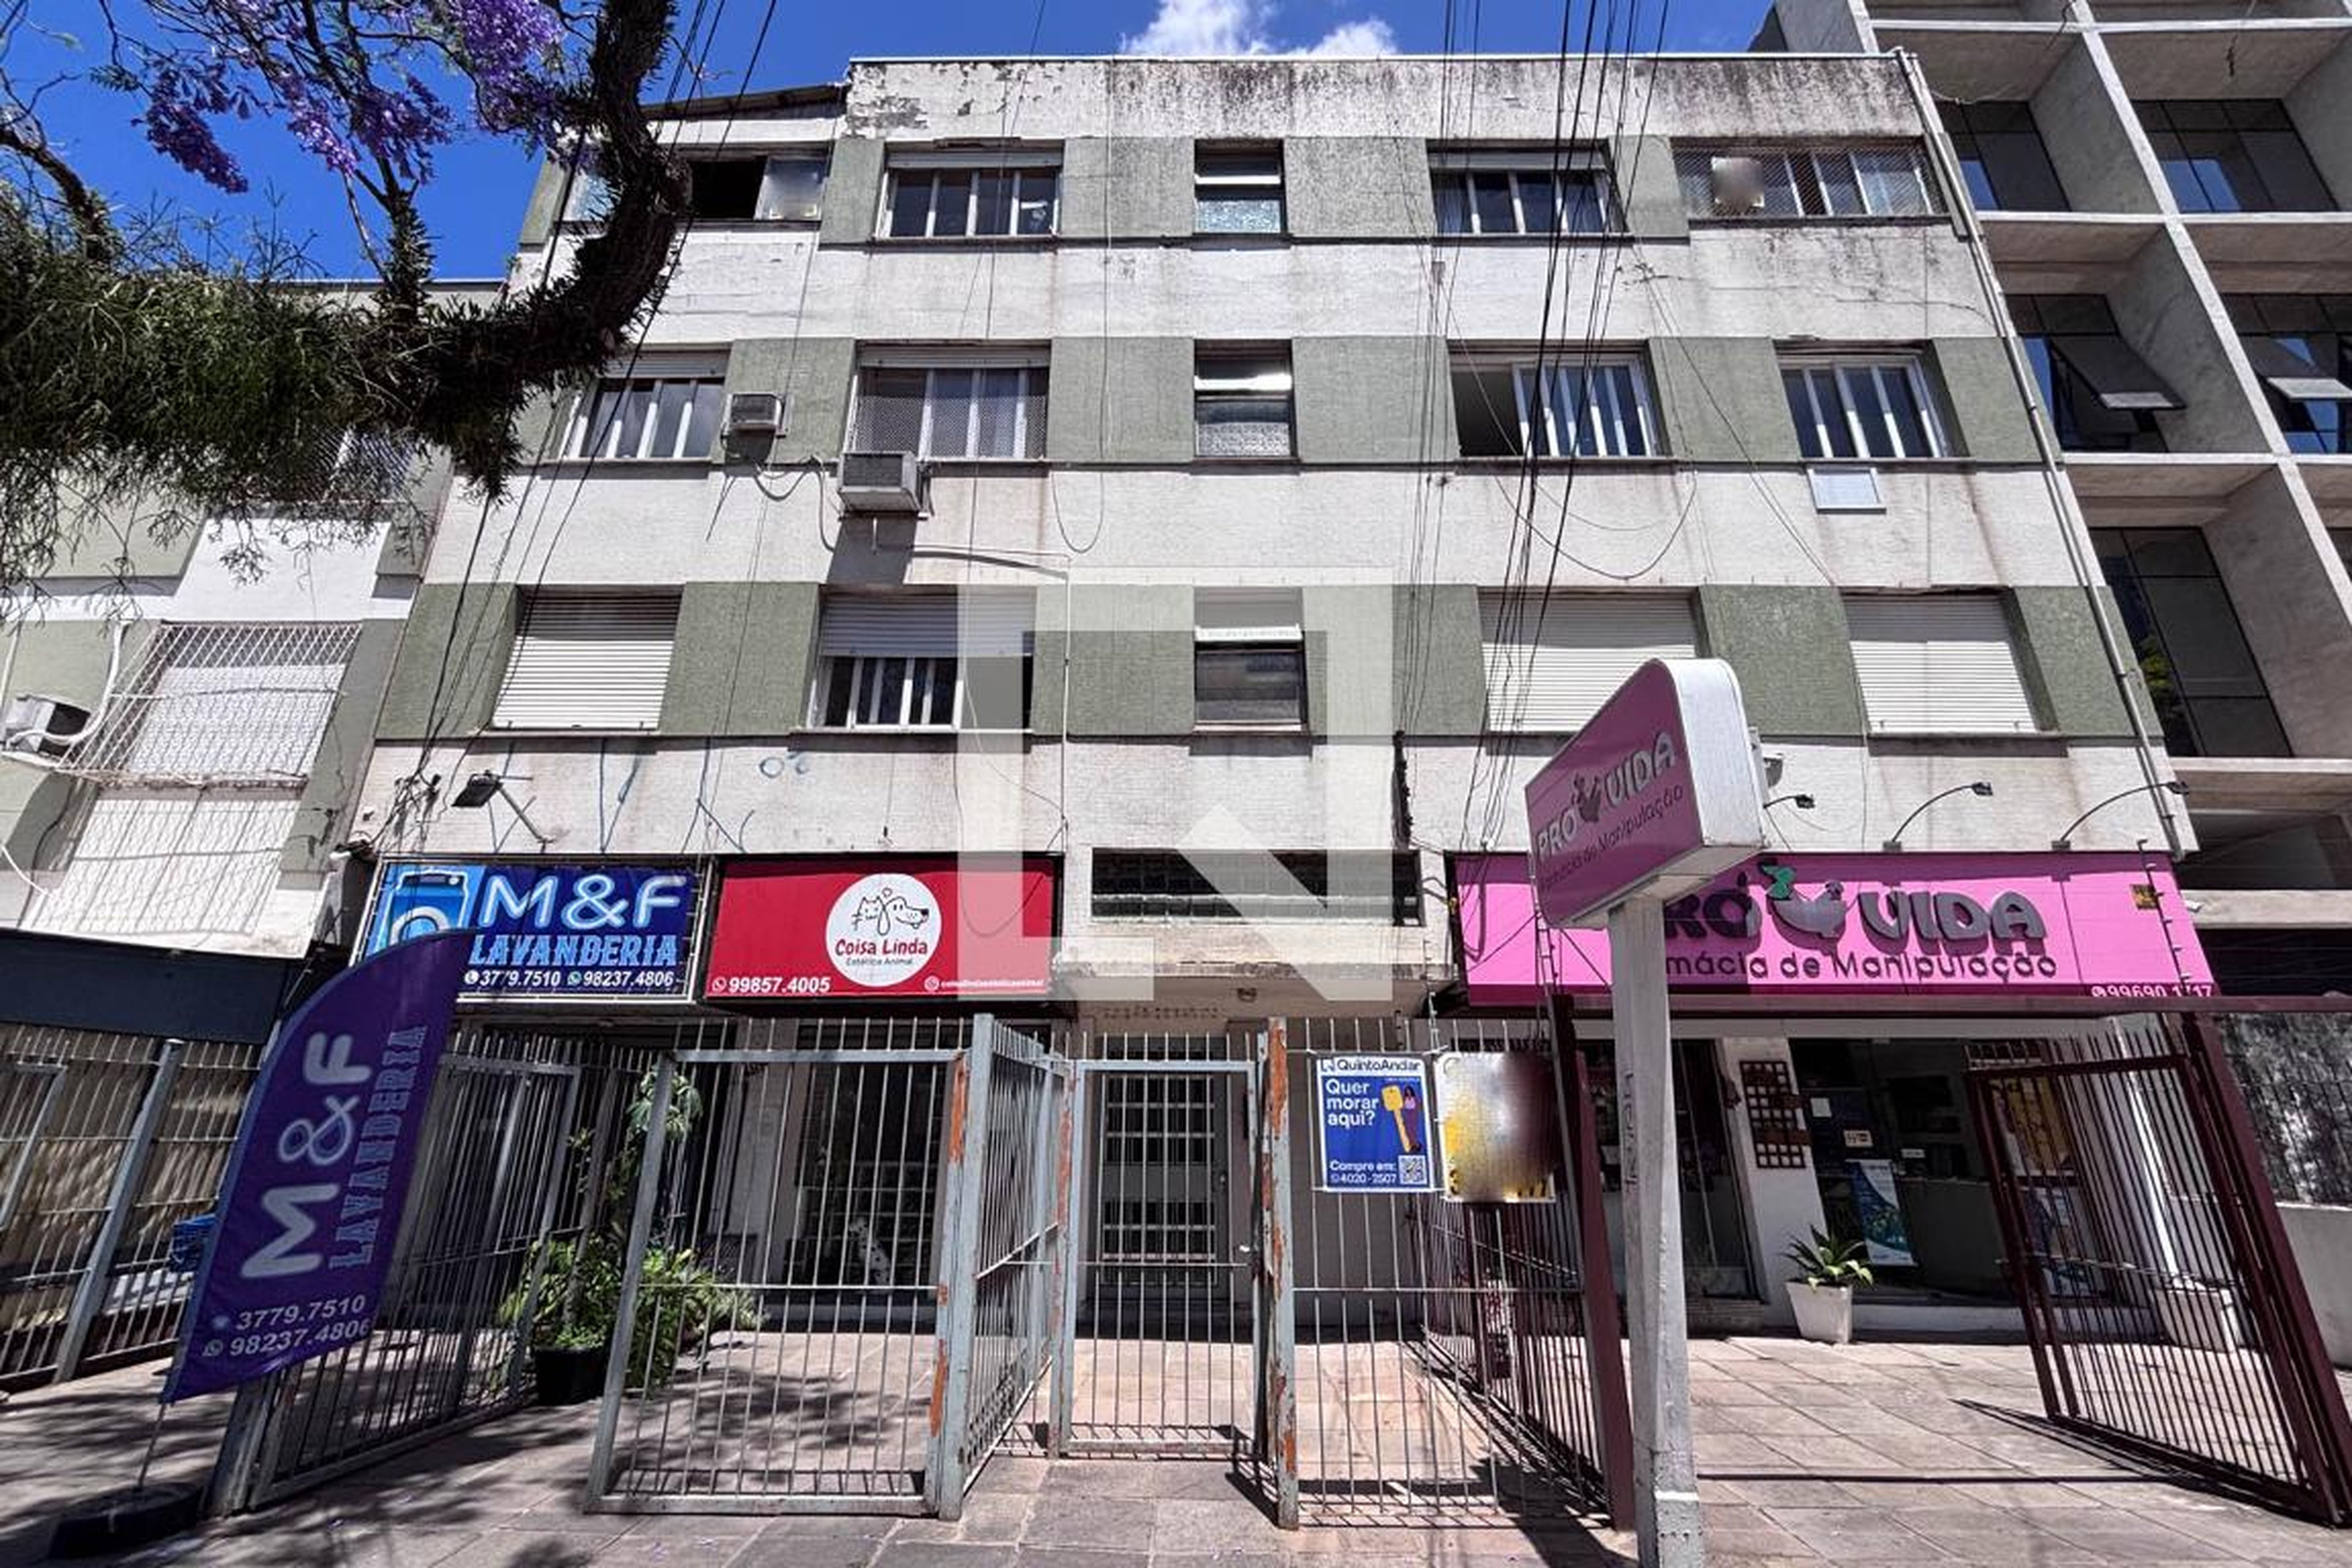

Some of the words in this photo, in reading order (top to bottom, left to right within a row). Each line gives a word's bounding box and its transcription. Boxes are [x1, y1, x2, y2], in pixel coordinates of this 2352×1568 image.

[1599, 785, 1683, 852] Manipulação
[479, 874, 687, 930] M&F
[1664, 872, 1762, 940] RÓ
[467, 934, 677, 967] LAVANDERIA
[835, 938, 876, 956] Coisa
[883, 939, 927, 956] Linda
[884, 957, 913, 965] Animal
[1666, 951, 1768, 978] mácia
[1781, 952, 1820, 978] de
[1831, 952, 2056, 984] Manipulação
[479, 970, 560, 987] 3779.7510
[584, 970, 674, 987] 98237.4806
[729, 977, 831, 993] 99857.4005
[1337, 1058, 1421, 1071] QuintoAndar
[1325, 1078, 1370, 1095] Quer
[1327, 1097, 1379, 1110] morar
[1328, 1110, 1375, 1129] aqui?
[328, 1024, 428, 1270] LAVANDERIA
[1330, 1159, 1374, 1172] Compre
[236, 1294, 366, 1330] 3779.7510
